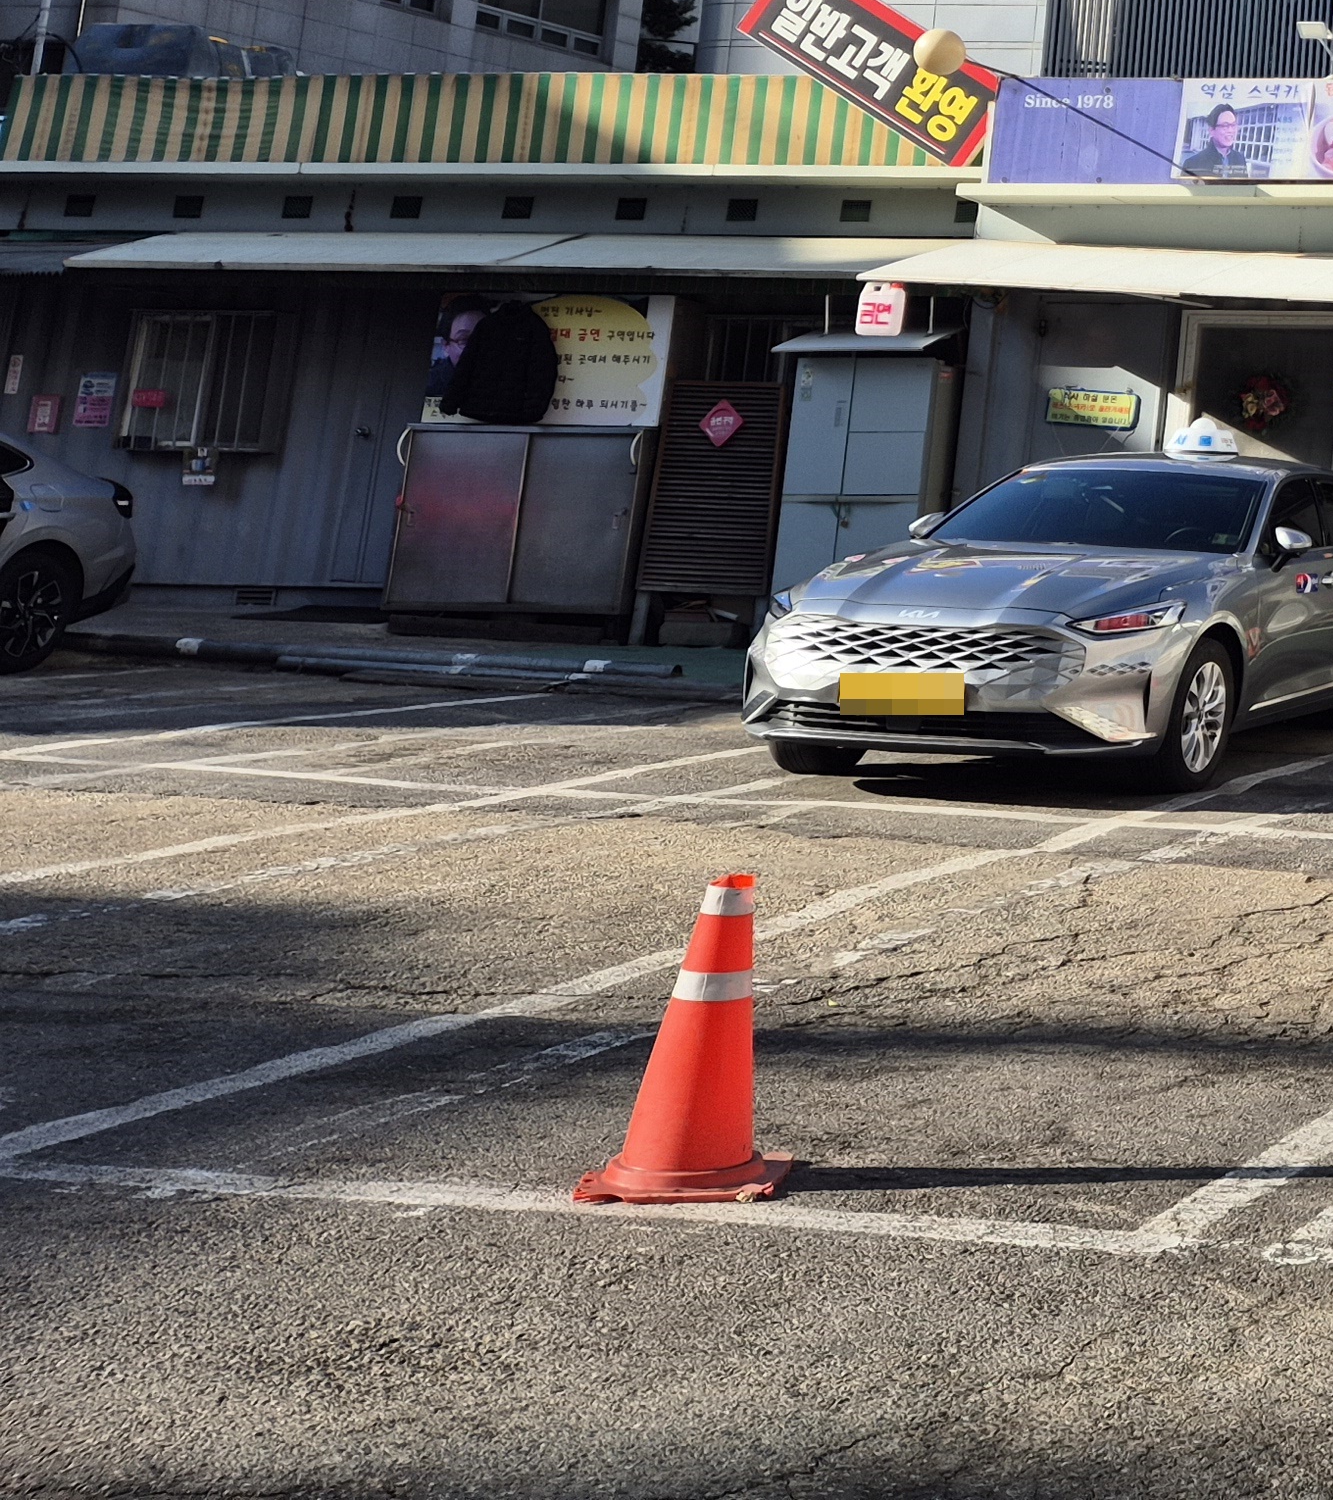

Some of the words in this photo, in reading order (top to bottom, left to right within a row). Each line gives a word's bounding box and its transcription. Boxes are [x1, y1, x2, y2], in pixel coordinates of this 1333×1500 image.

[1201, 83, 1235, 99] 역삼
[1247, 84, 1299, 99] 스낵카
[895, 68, 978, 142] 환영
[1024, 94, 1070, 109] Since
[1076, 94, 1114, 109] 1978
[860, 302, 893, 325] 금연
[578, 328, 600, 341] 금연
[607, 330, 655, 341] 구역입니다
